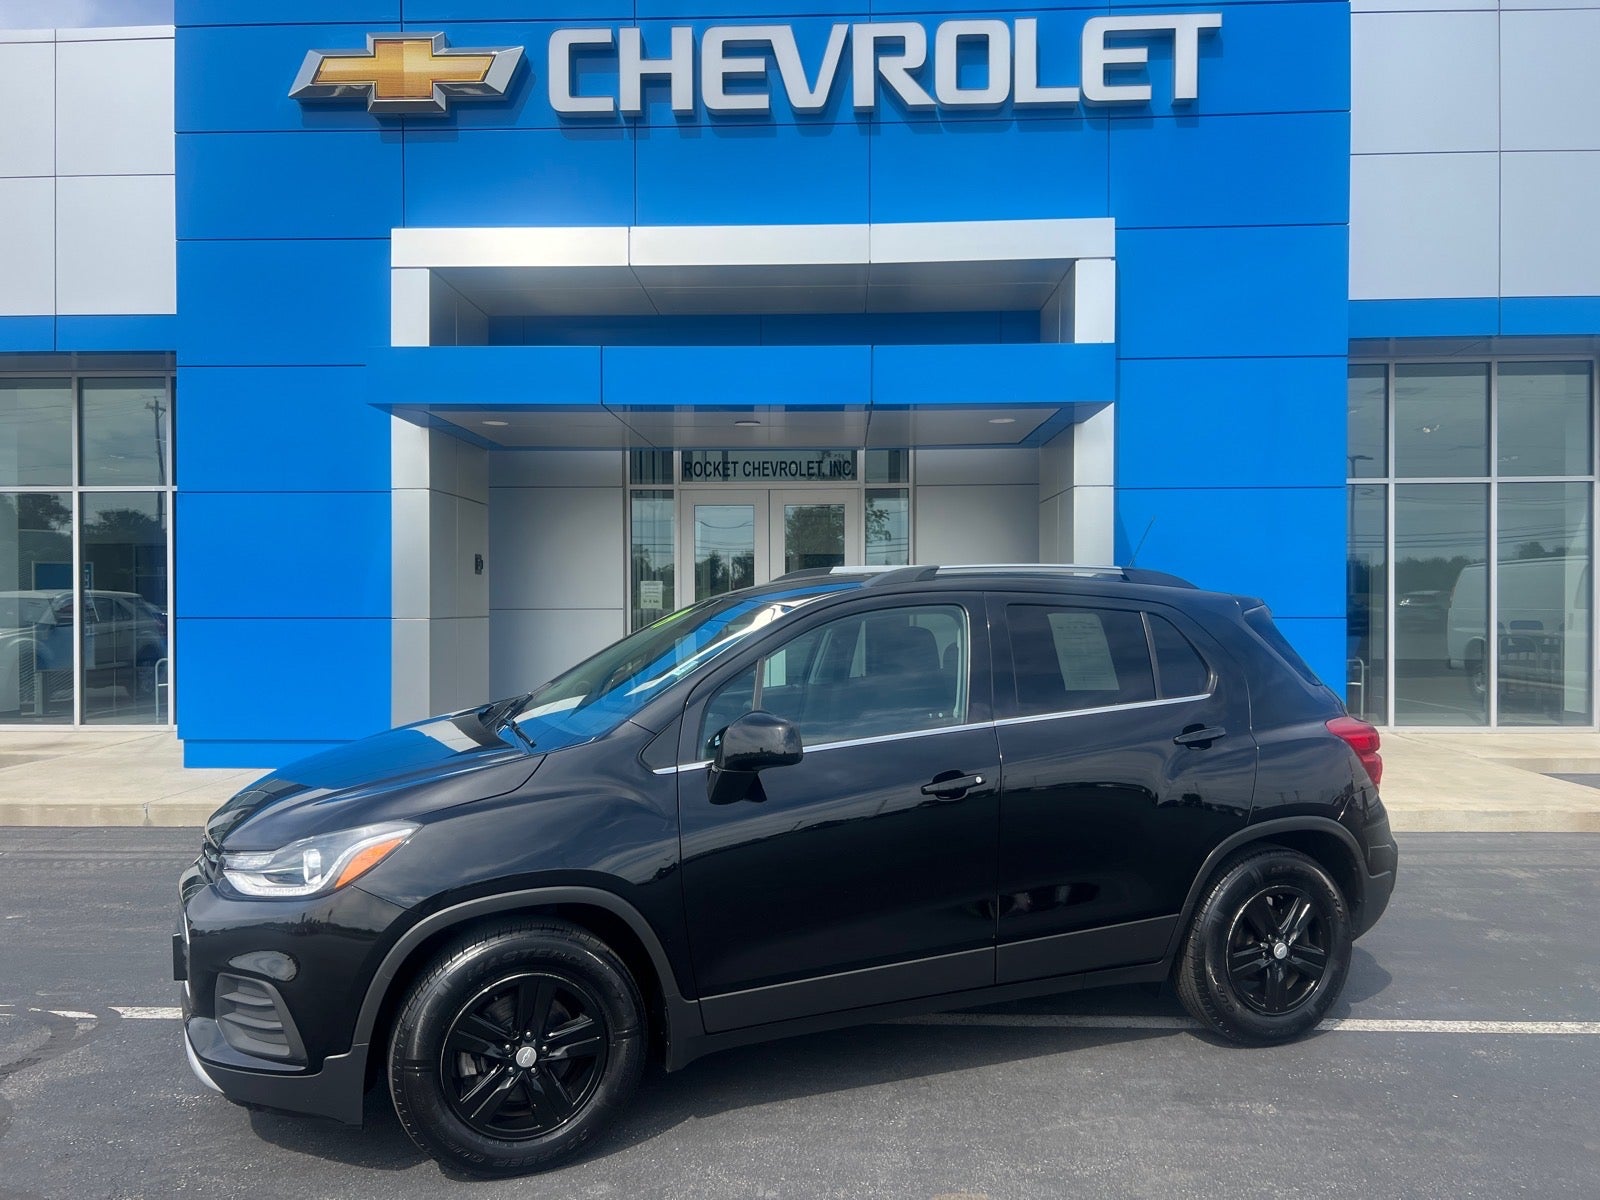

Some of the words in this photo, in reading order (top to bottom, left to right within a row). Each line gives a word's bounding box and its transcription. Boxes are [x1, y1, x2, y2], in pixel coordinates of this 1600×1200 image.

[548, 13, 1222, 115] CHEVROLET
[684, 460, 739, 478] ROCKET
[829, 460, 855, 477] INC.
